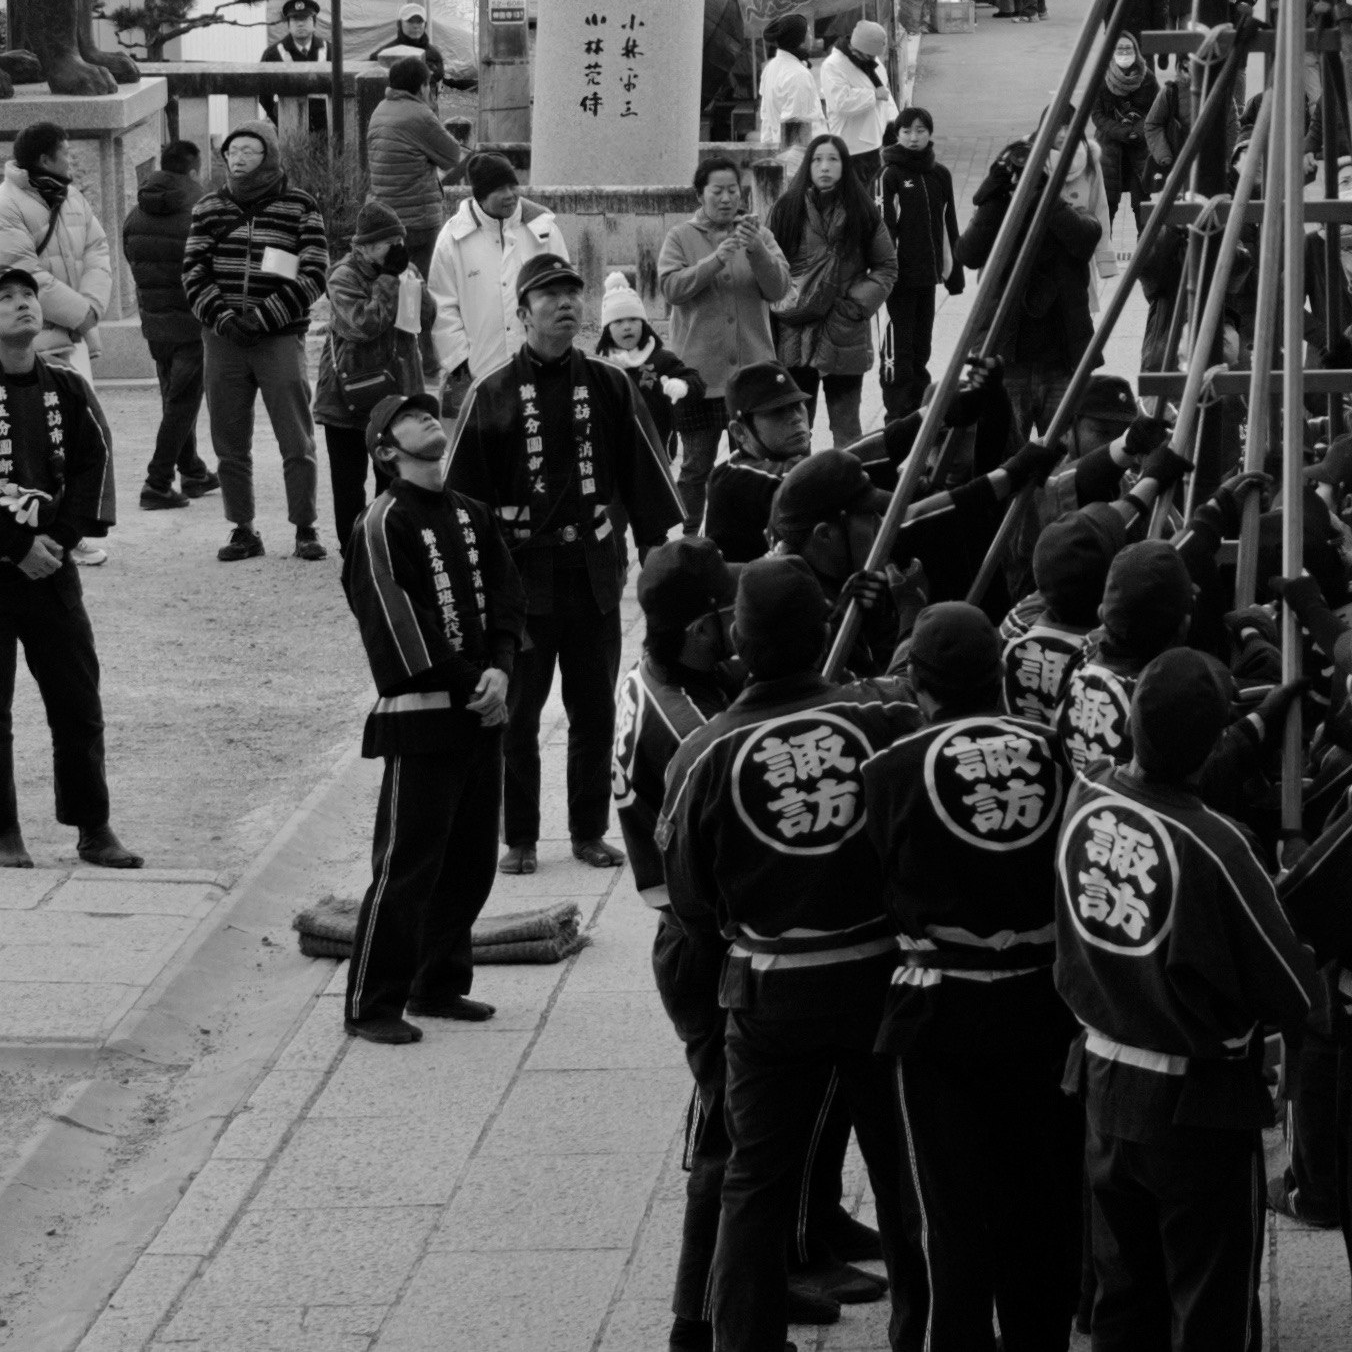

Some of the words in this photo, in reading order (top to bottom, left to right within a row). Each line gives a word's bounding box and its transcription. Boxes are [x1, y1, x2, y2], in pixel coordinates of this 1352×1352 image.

[573, 385, 597, 495] 諏訪消防團
[752, 724, 861, 840] 諏訪
[943, 733, 1047, 834] 諏訪
[1078, 810, 1160, 941] 諏訪
